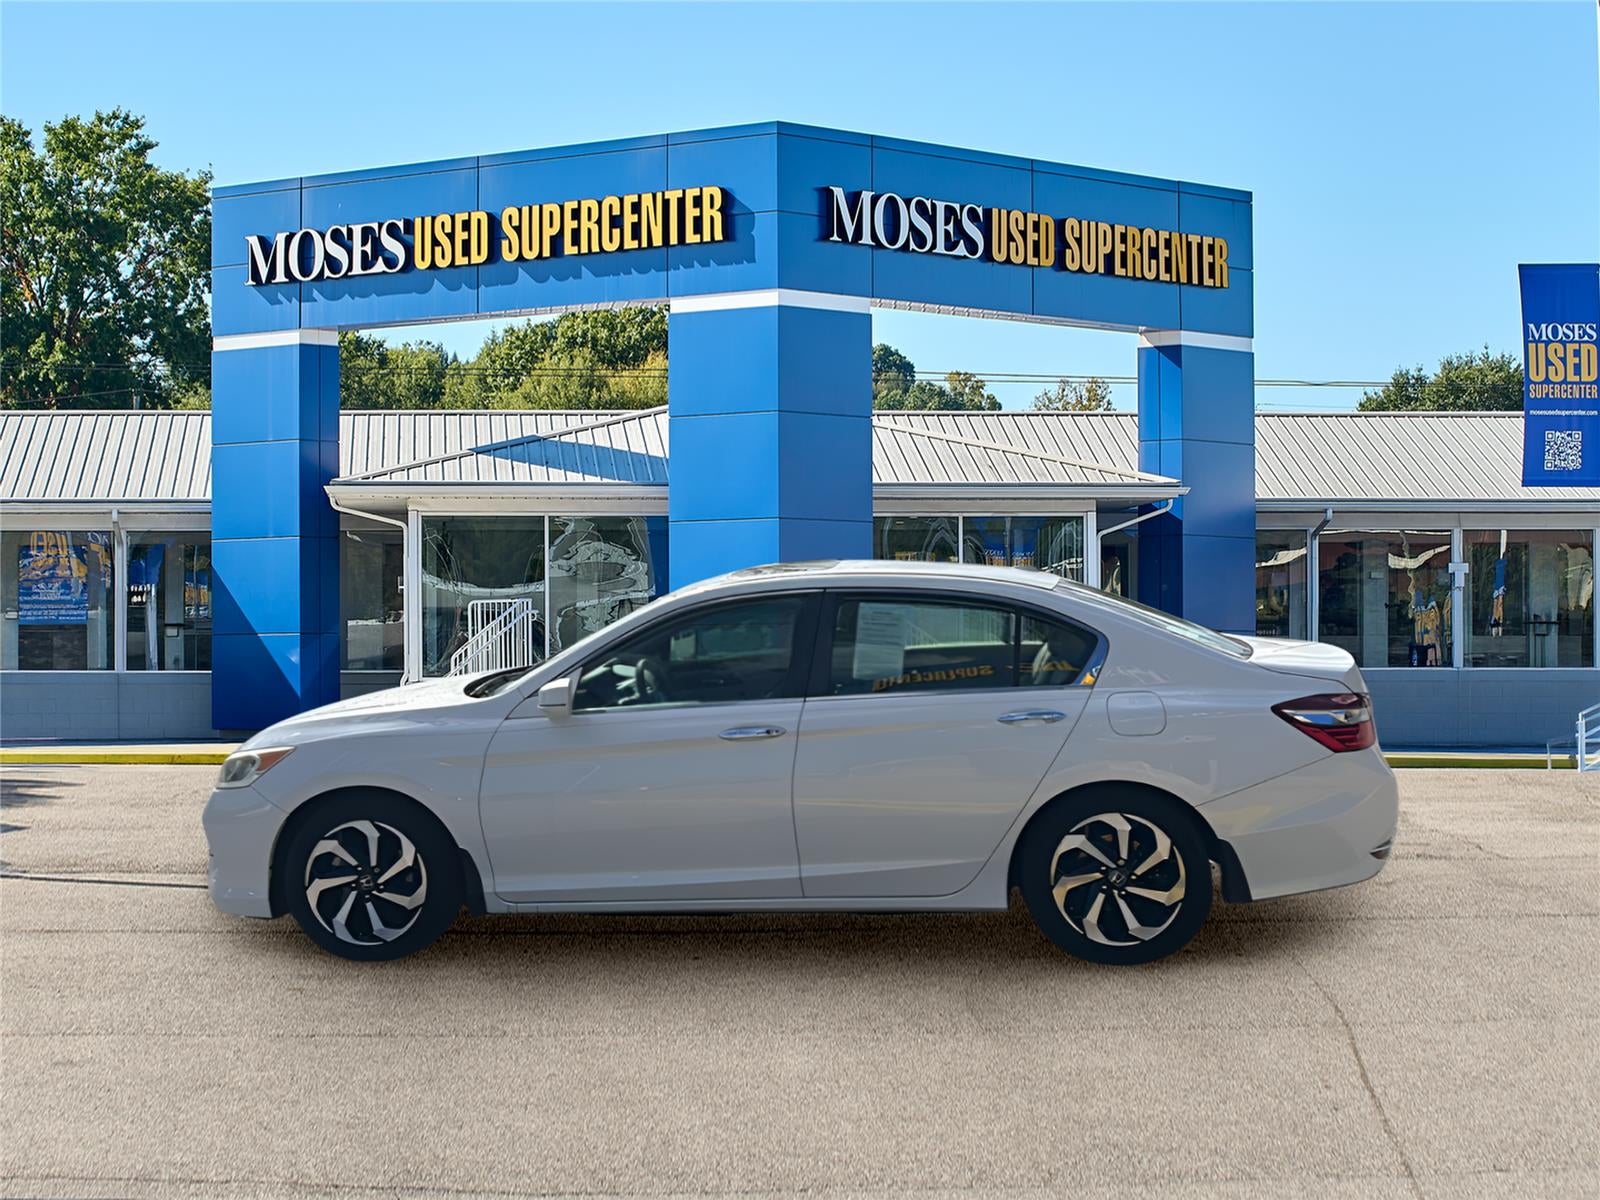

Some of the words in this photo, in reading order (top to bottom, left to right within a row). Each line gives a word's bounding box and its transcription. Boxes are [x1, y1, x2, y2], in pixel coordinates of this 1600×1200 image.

[244, 218, 406, 286] MOSES
[413, 210, 488, 270] USED
[501, 186, 724, 262] SUPERCENTER
[829, 185, 985, 259] MOSES
[991, 207, 1055, 267] USED
[1065, 217, 1229, 289] SUPERCENTER
[1527, 322, 1597, 341] MOSES
[1528, 342, 1598, 382] USED
[1529, 383, 1598, 399] SUPERCENTER
